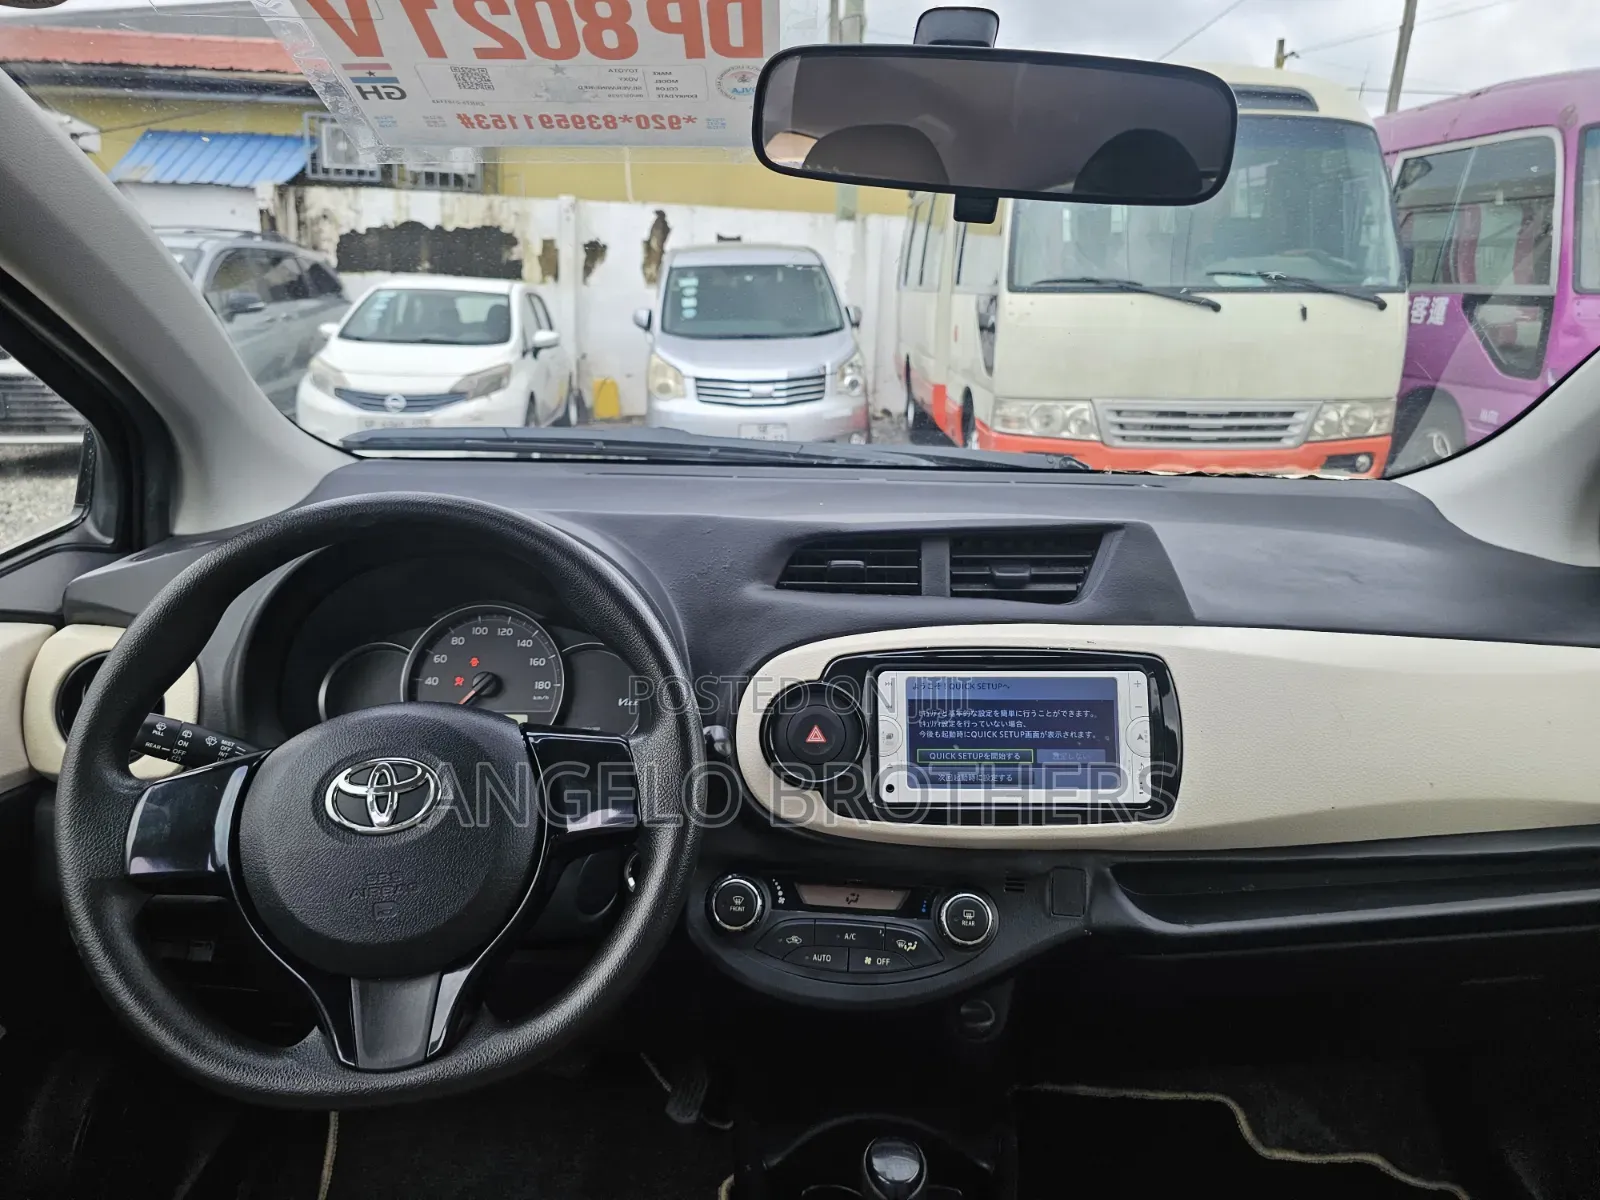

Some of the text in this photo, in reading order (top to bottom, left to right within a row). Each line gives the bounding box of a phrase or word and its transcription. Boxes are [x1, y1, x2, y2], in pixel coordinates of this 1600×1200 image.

[1408, 295, 1450, 326] 客運
[471, 626, 514, 637] 100 120
[450, 636, 466, 647] 80
[516, 638, 534, 649] 140
[433, 654, 448, 665] 60
[529, 657, 547, 668] 160
[424, 677, 440, 687] 40
[534, 680, 552, 690] 180
[152, 729, 165, 737] PULL
[145, 741, 162, 750] REAR
[178, 740, 189, 748] ON
[221, 740, 237, 748] MIST
[172, 748, 187, 757] OFF
[220, 745, 232, 753] OFF
[929, 752, 956, 761] QUICK
[729, 905, 746, 913] FRONT
[961, 919, 976, 928] REAR
[844, 932, 857, 941] A/C
[812, 953, 832, 963] AUTO
[876, 957, 891, 966] OFF
